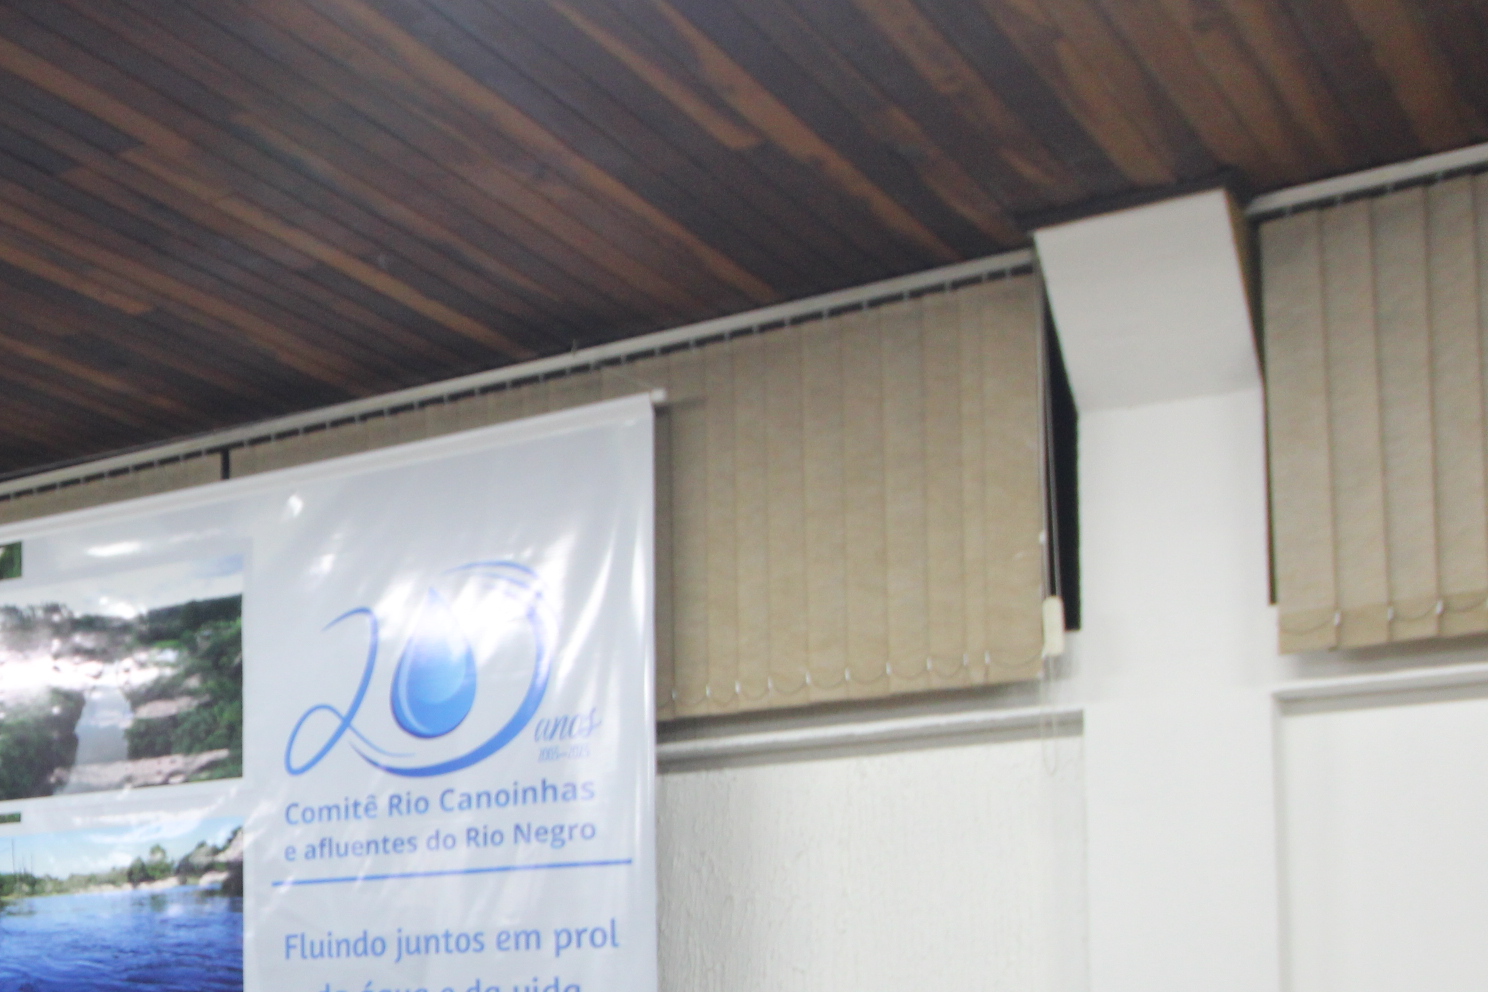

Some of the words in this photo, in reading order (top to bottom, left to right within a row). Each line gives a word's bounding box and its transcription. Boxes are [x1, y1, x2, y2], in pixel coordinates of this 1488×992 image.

[285, 795, 378, 825] Comitê
[389, 792, 430, 817] Rio
[439, 778, 595, 812] Canoinhas
[284, 845, 297, 861] e
[304, 835, 417, 860] afluentes
[426, 829, 456, 851] do
[466, 824, 504, 847] Rio
[514, 822, 596, 849] Negro
[284, 930, 386, 960] Fluindo
[395, 928, 485, 964] juntos
[495, 928, 541, 951] em
[554, 917, 620, 957] prol
